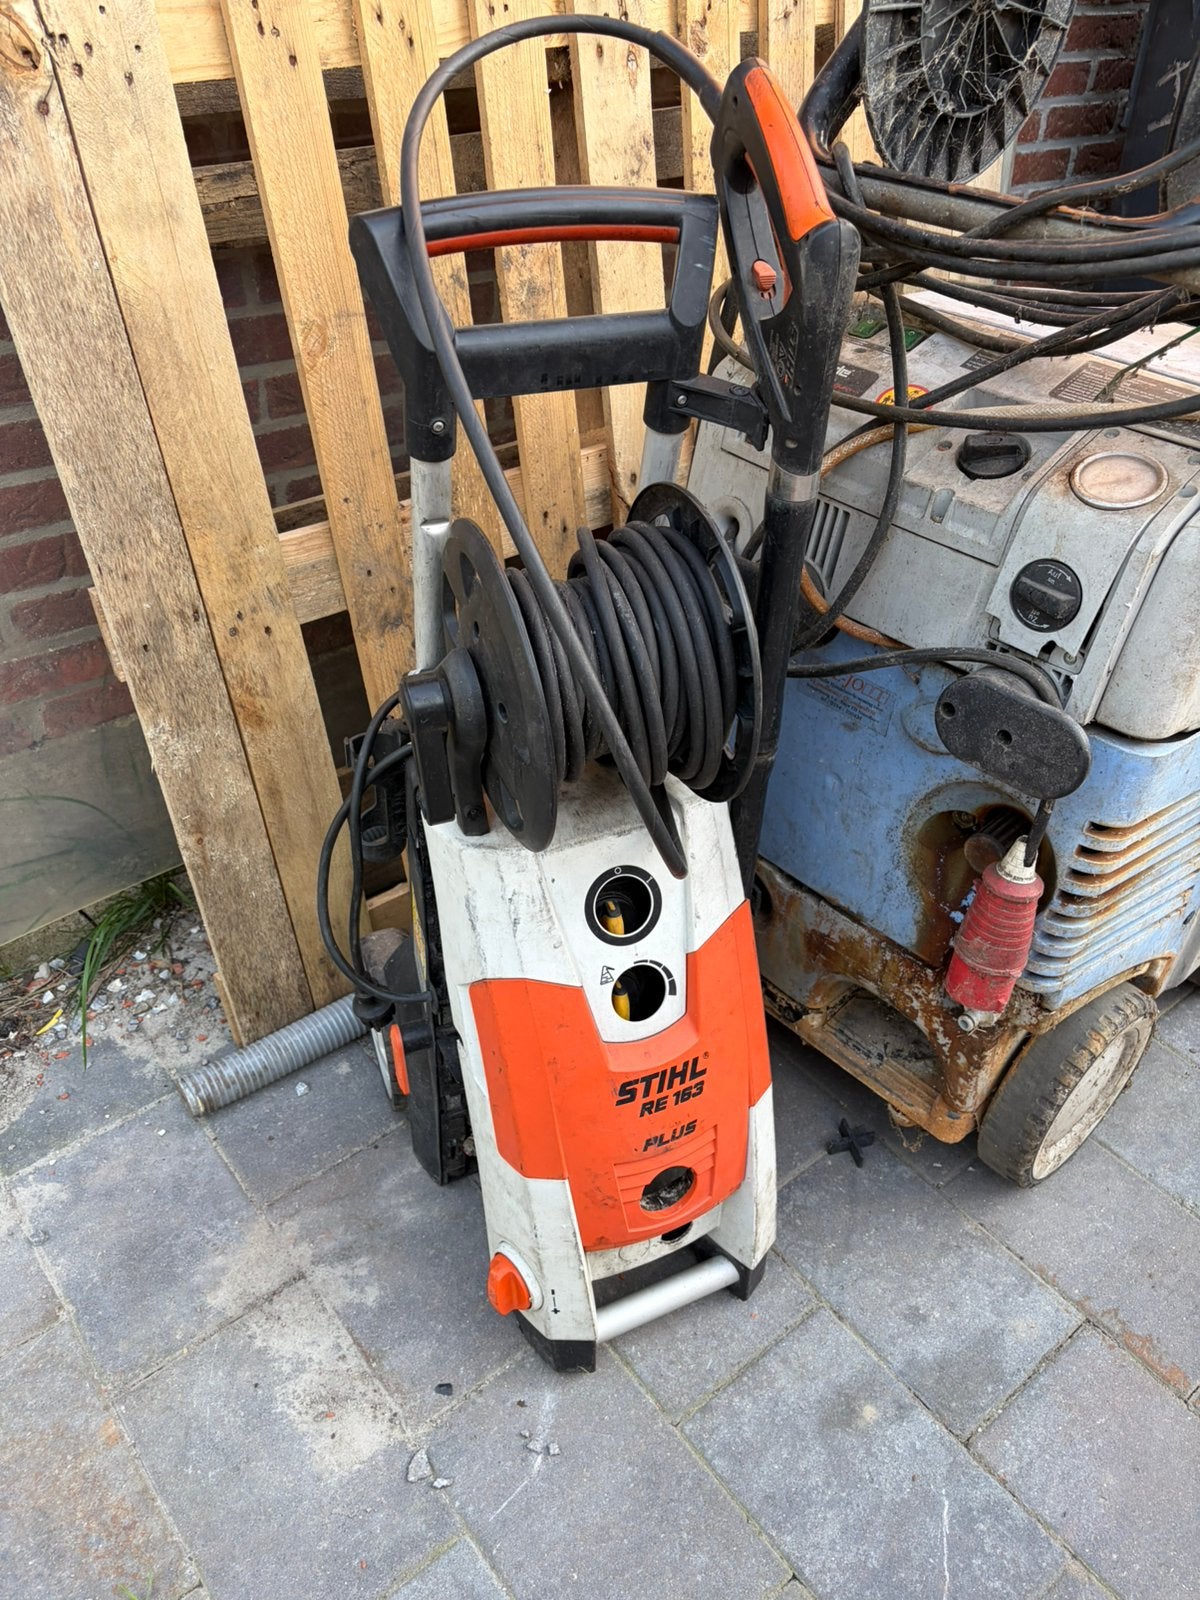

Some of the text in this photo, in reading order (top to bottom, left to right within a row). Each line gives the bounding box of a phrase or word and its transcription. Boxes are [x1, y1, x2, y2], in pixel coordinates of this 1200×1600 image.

[615, 1056, 708, 1107] STIHL
[639, 1080, 705, 1118] RE 163
[642, 1119, 698, 1153] PLUS
